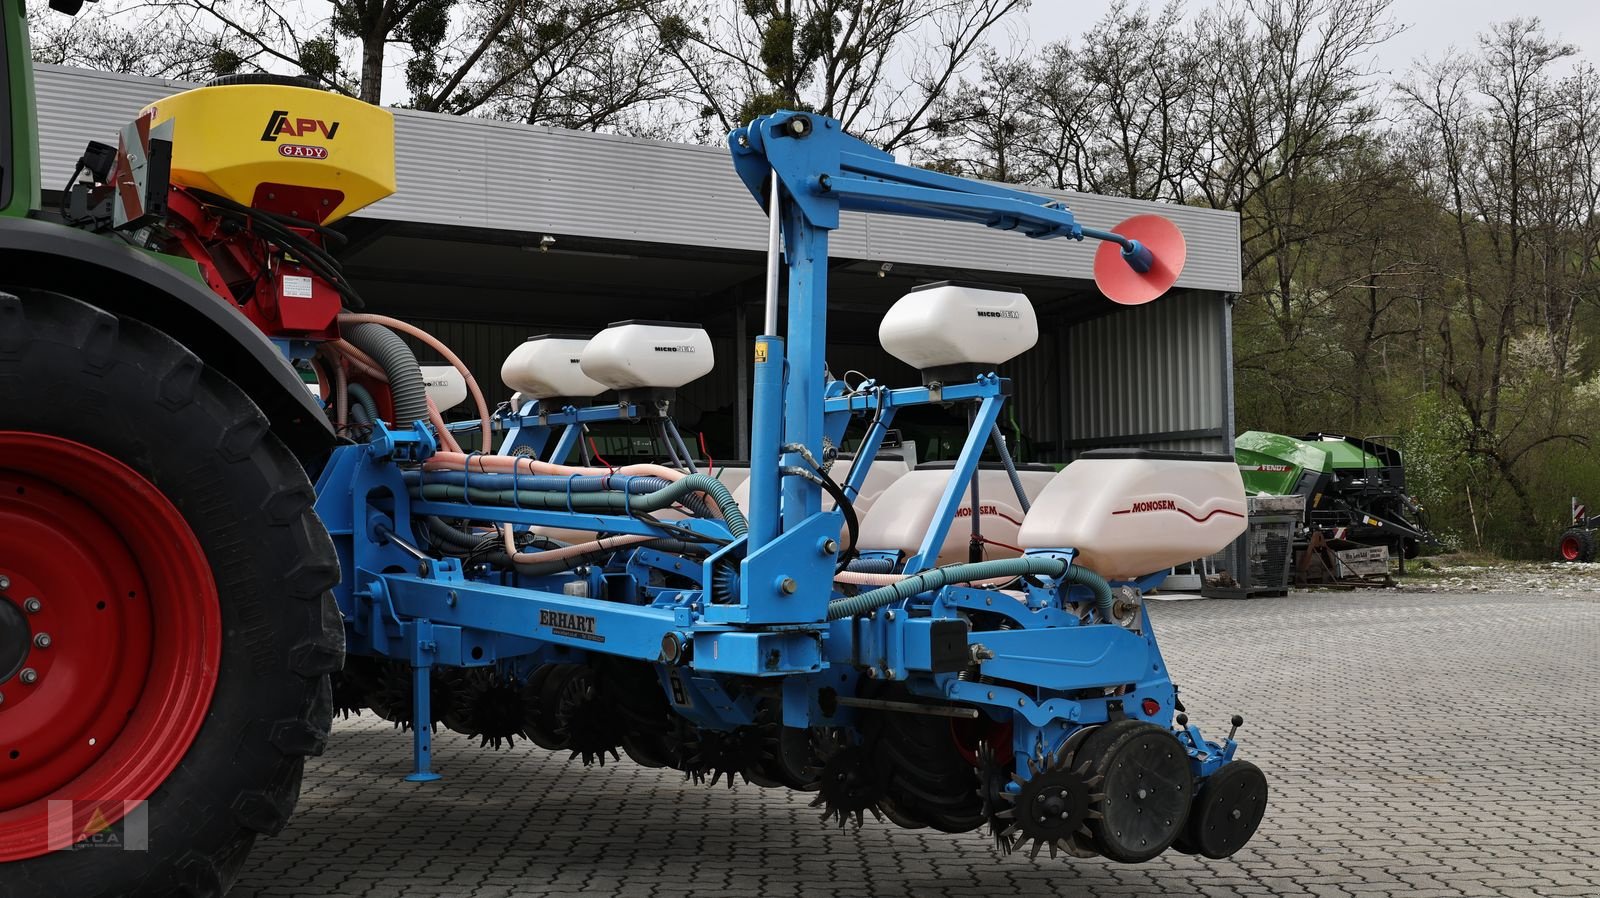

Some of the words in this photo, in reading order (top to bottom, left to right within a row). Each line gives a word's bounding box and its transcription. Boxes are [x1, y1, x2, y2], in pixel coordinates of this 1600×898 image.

[267, 114, 340, 140] APV
[283, 146, 323, 157] GADY
[977, 311, 1019, 319] MICROSEM
[955, 505, 998, 518] MONSEM
[1132, 500, 1176, 513] MONOSEM
[540, 609, 595, 633] ERHART
